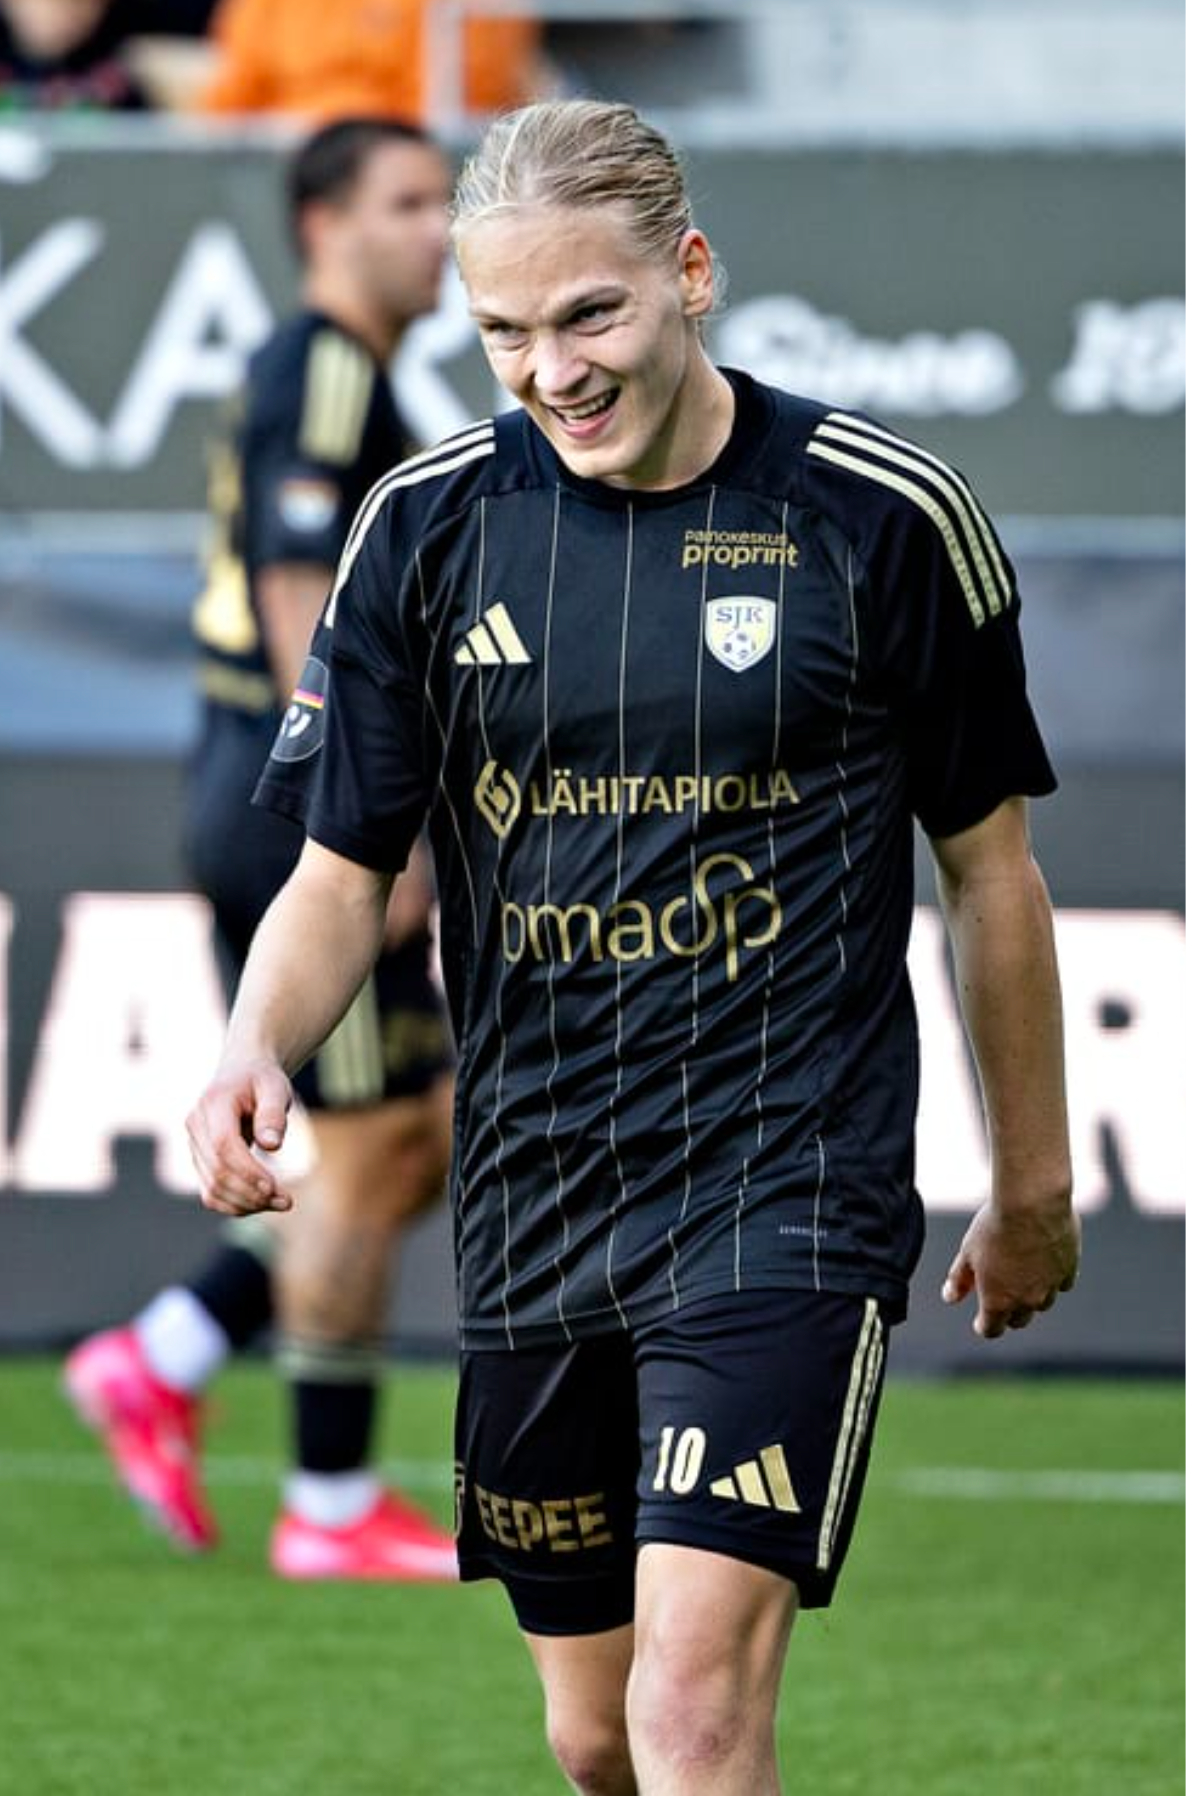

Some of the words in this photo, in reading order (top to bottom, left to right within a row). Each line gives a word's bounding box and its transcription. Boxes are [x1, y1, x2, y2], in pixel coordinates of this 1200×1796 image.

[682, 544, 799, 569] proprint
[716, 606, 763, 629] SJK
[530, 768, 800, 816] LÄHITAPIOLA
[652, 1426, 706, 1495] 10
